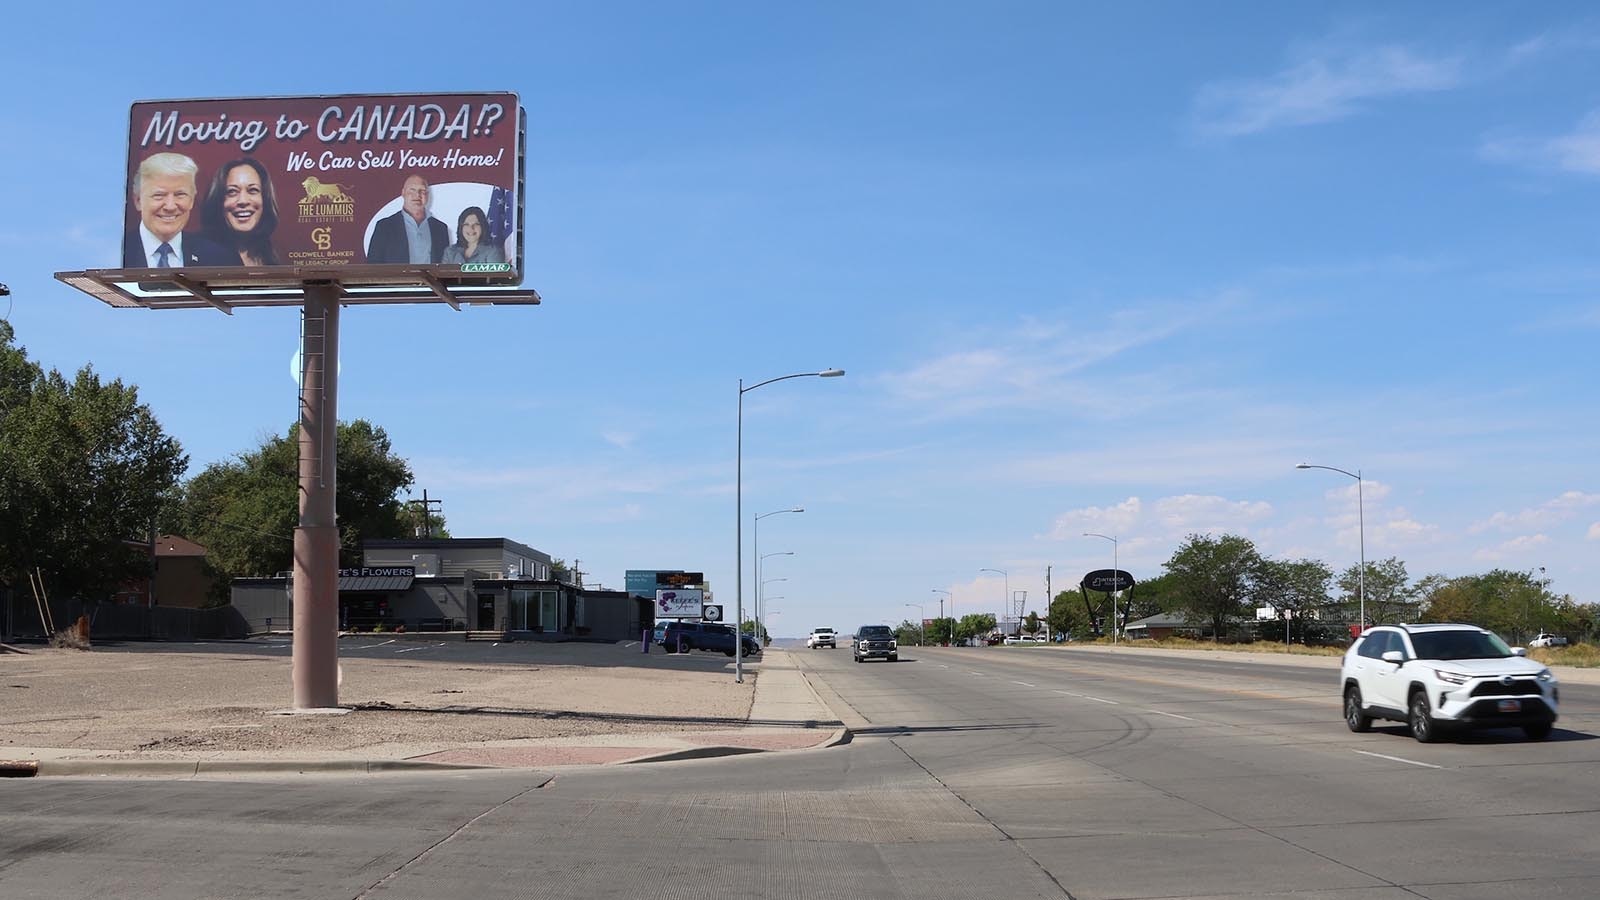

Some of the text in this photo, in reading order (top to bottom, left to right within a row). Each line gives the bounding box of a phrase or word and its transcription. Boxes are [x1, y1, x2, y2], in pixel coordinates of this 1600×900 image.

[141, 104, 503, 150] Moving to CANADA!?
[287, 148, 504, 171] We Can Sell Your Home!
[298, 203, 354, 216] THE LUMMUS
[338, 568, 359, 576] FE'S
